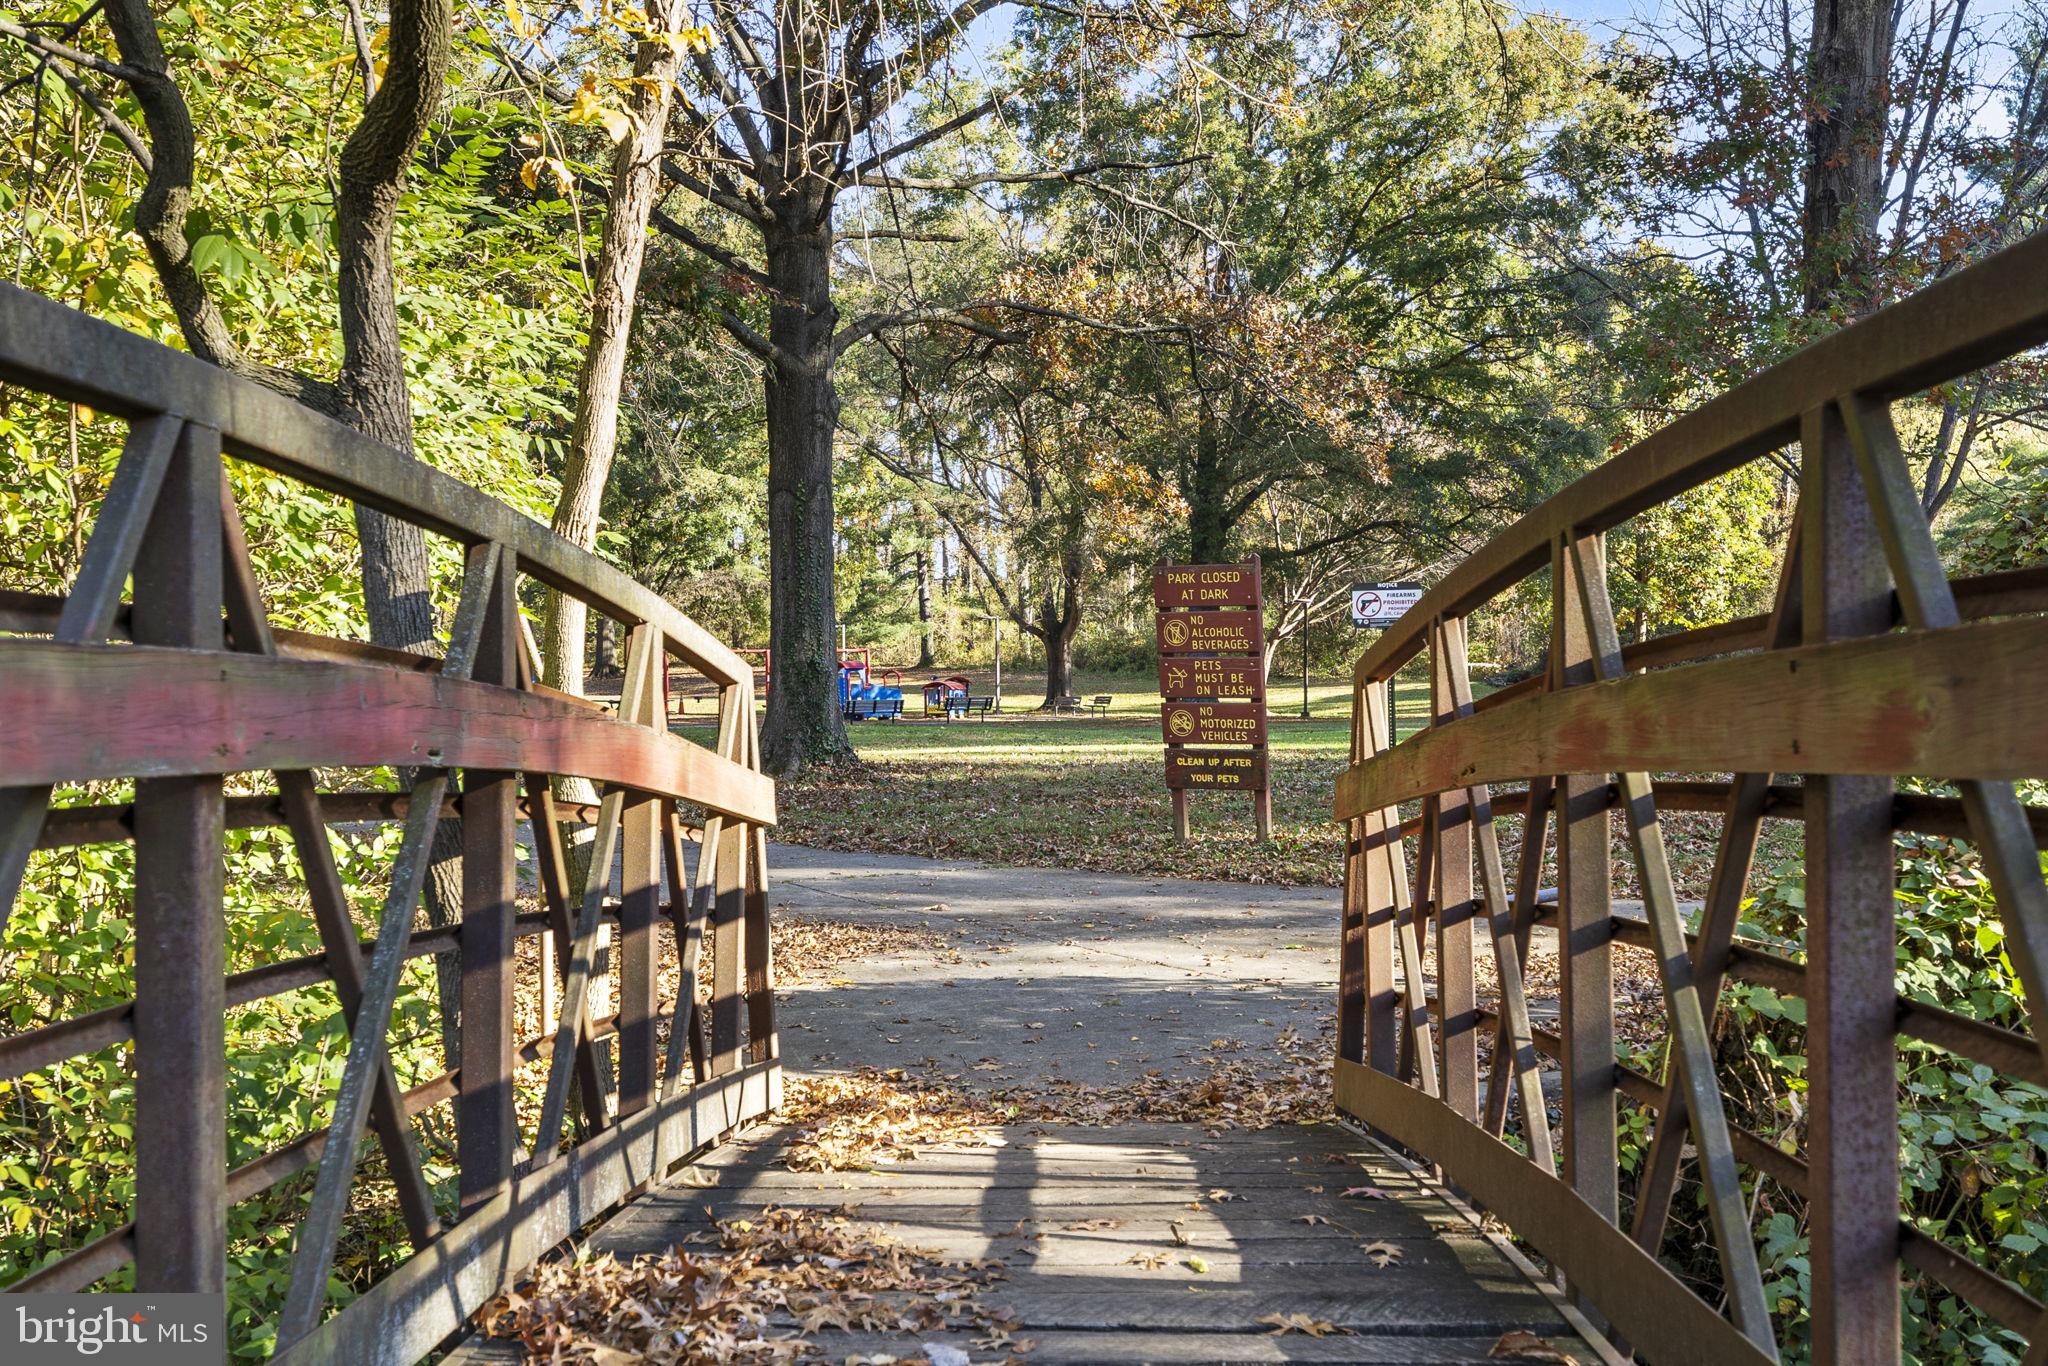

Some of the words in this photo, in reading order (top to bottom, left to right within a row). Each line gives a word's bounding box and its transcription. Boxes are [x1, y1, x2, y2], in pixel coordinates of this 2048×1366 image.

[1168, 573, 1195, 584] PARK
[1201, 572, 1240, 583] CLOSED
[1182, 589, 1194, 600] AT
[1200, 589, 1228, 600] DARK
[1190, 615, 1204, 625] NO
[1191, 627, 1244, 637] ALCOHOLIC
[1192, 639, 1249, 650] BEVERAGES
[1194, 660, 1222, 671] PETS
[1195, 673, 1224, 683] MUST
[1231, 673, 1244, 683] BE
[1196, 685, 1210, 695] ON
[1218, 685, 1253, 695] LEASH
[1199, 706, 1213, 716] NO
[1200, 719, 1256, 729] MOTORIZED
[1201, 731, 1248, 741] VEHICLES
[1177, 757, 1204, 766] CLEAN
[1208, 758, 1220, 766] UP
[1223, 758, 1252, 767] AFTER
[1190, 774, 1213, 782] YOUR
[1217, 774, 1240, 783] PETS
